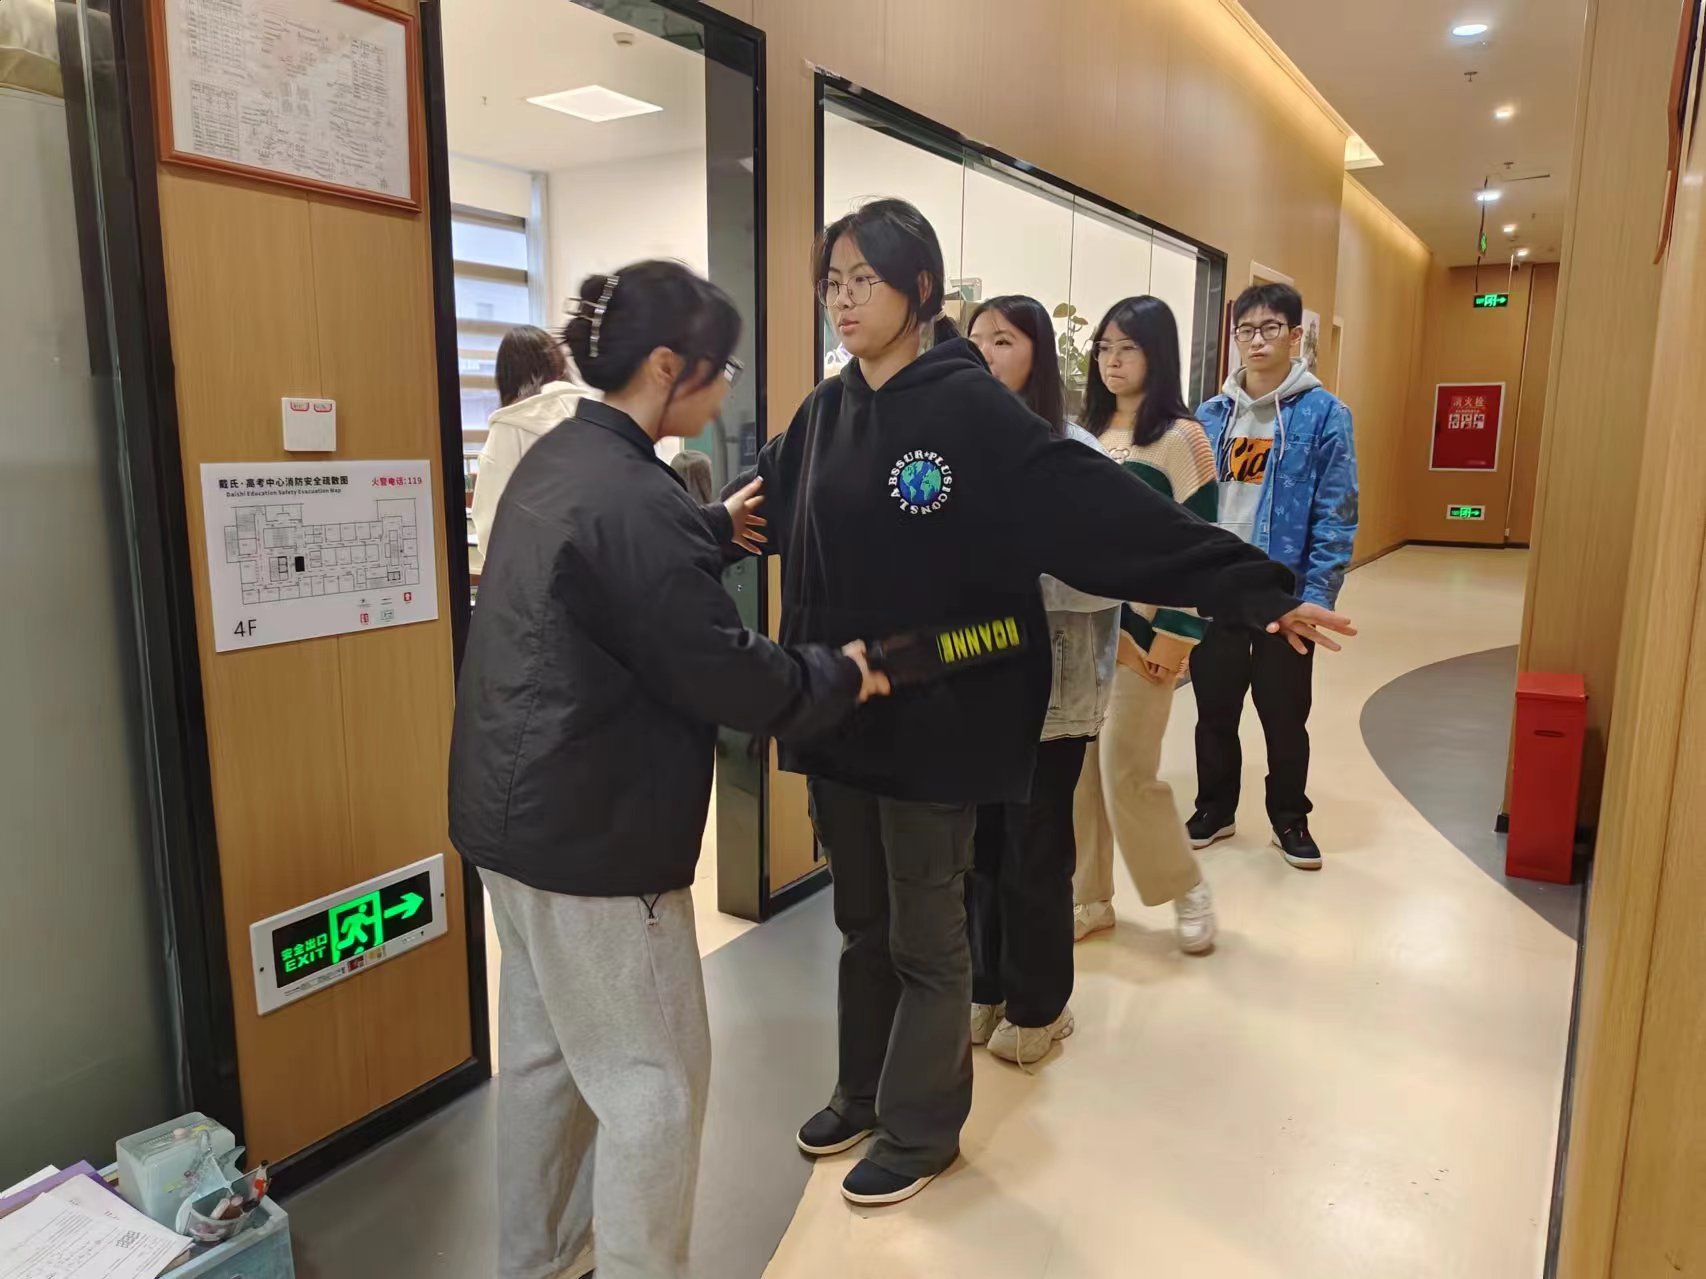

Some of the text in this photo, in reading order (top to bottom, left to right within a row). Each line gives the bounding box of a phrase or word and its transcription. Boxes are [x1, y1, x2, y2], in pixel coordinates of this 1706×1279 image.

[233, 619, 257, 637] 4F
[281, 933, 328, 961] 安全出口
[285, 946, 327, 973] EXIT
